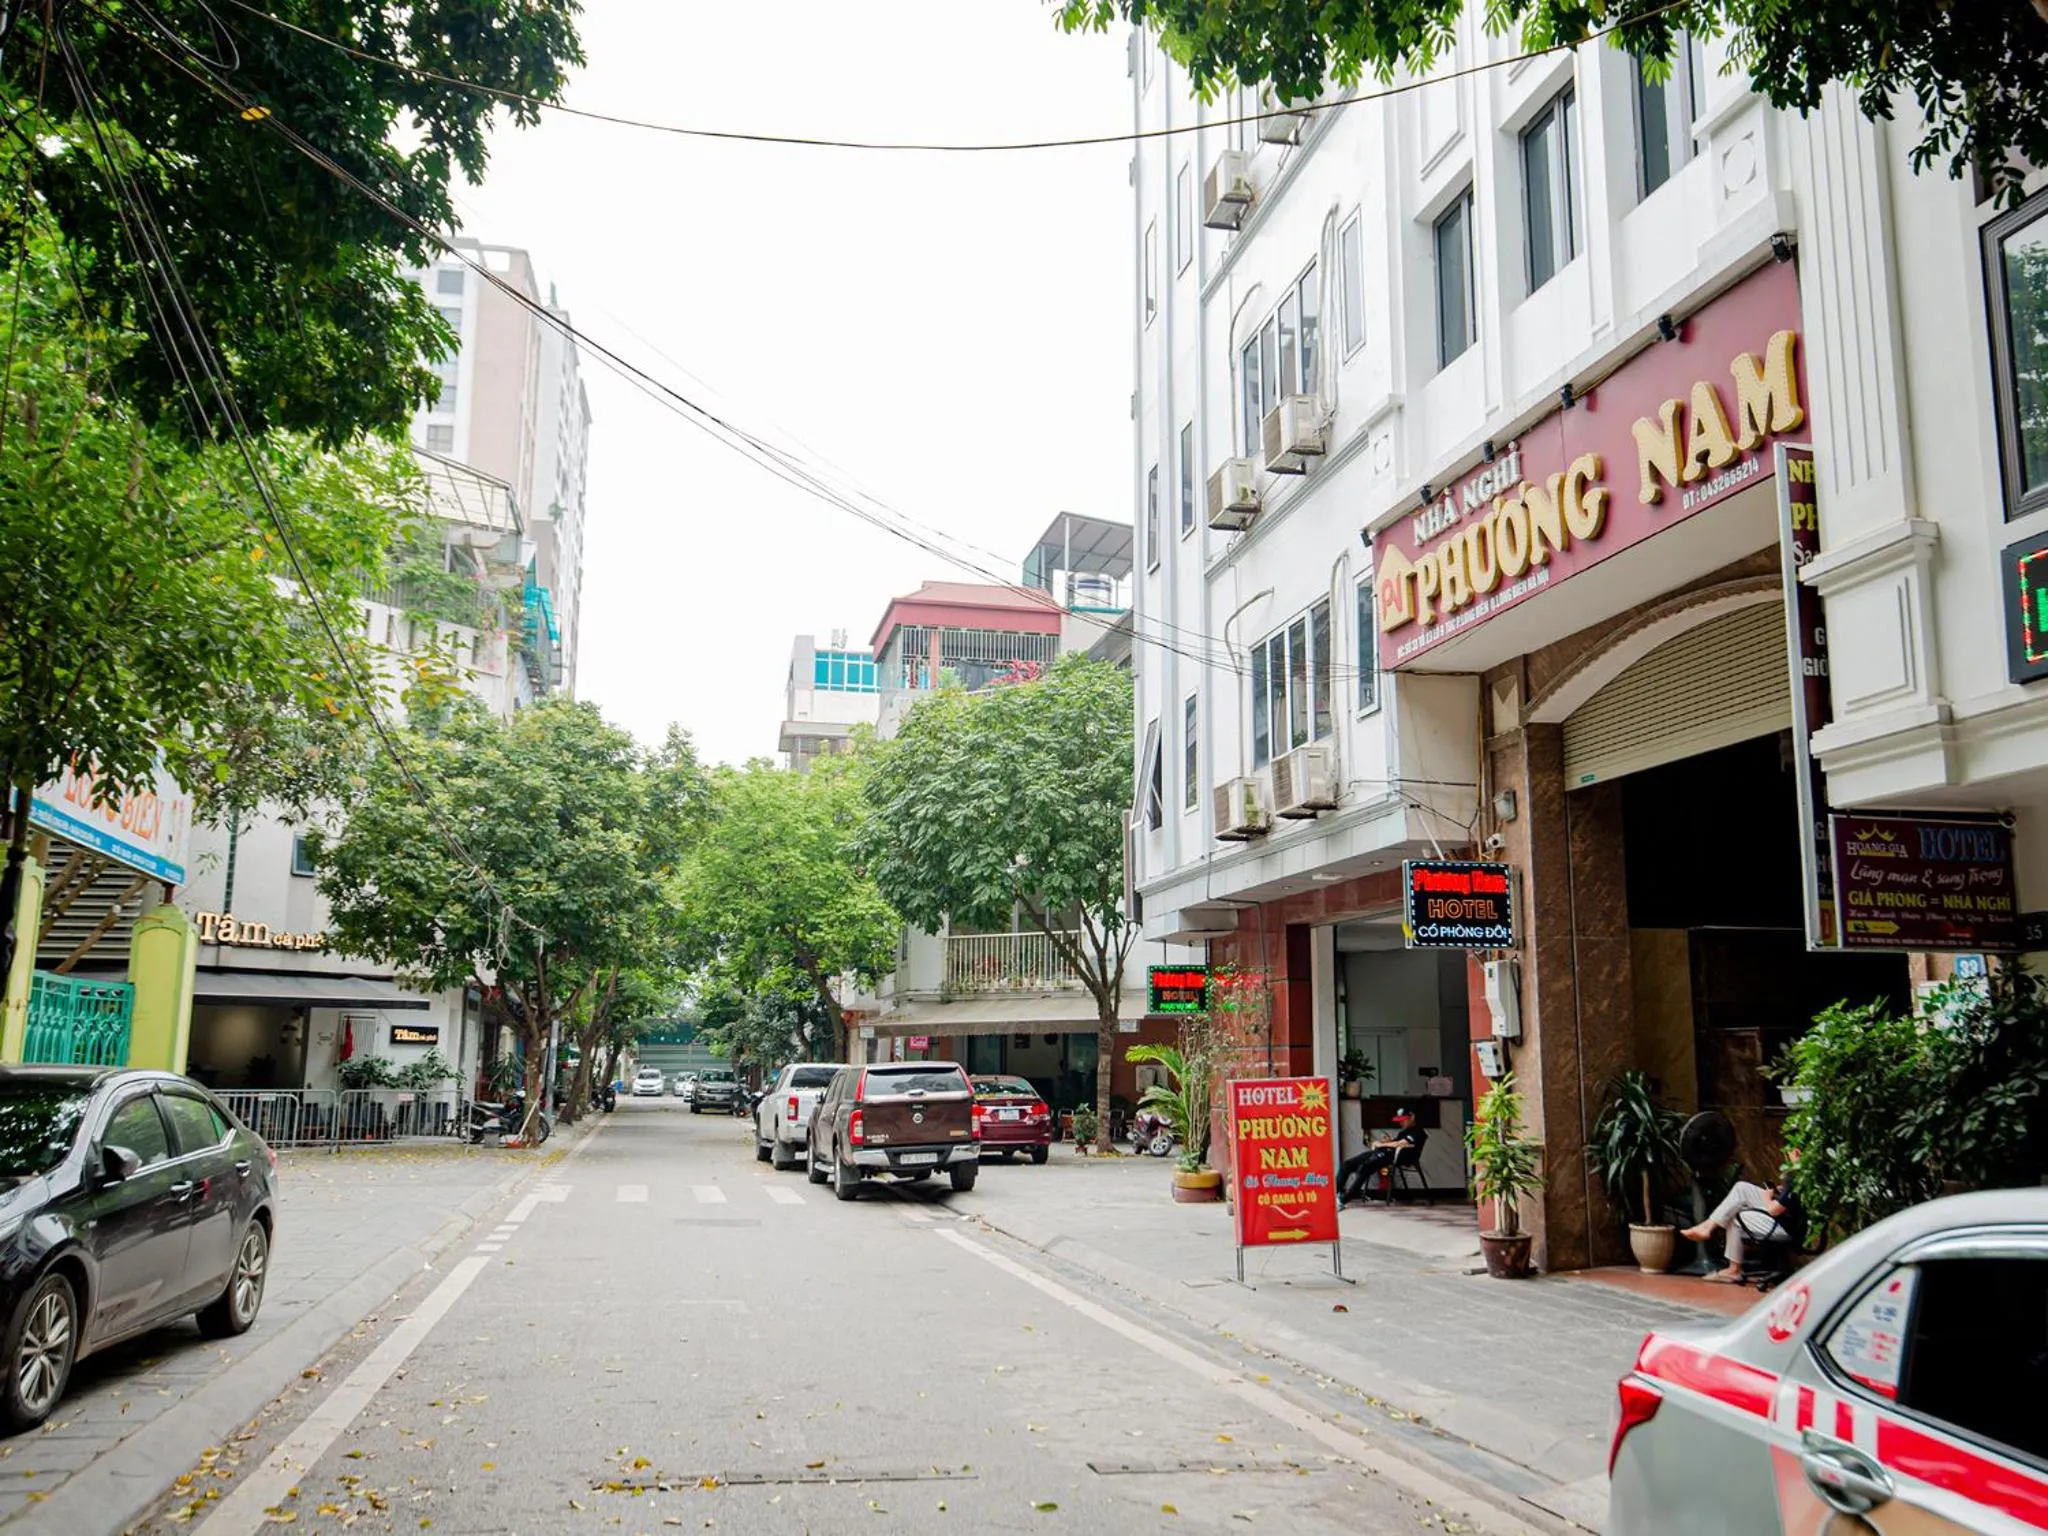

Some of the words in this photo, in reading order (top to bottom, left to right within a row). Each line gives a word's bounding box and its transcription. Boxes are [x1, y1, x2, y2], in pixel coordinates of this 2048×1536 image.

[1414, 452, 1609, 626] PHƯƠNG
[1631, 330, 1804, 504] NAM
[1414, 486, 1462, 546] NHÀ
[1919, 827, 2006, 862] HOTEL
[1427, 898, 1498, 919] HOTEL
[196, 911, 274, 946] Tâm
[273, 931, 294, 946] cà
[1418, 923, 1439, 938] CÓ
[1439, 923, 1484, 938] PHÒNG
[1485, 923, 1508, 938] ĐÔI
[1238, 1086, 1299, 1107] HOTEL
[1238, 1112, 1328, 1140] PHƯƠNG
[1259, 1145, 1310, 1170] NAM
